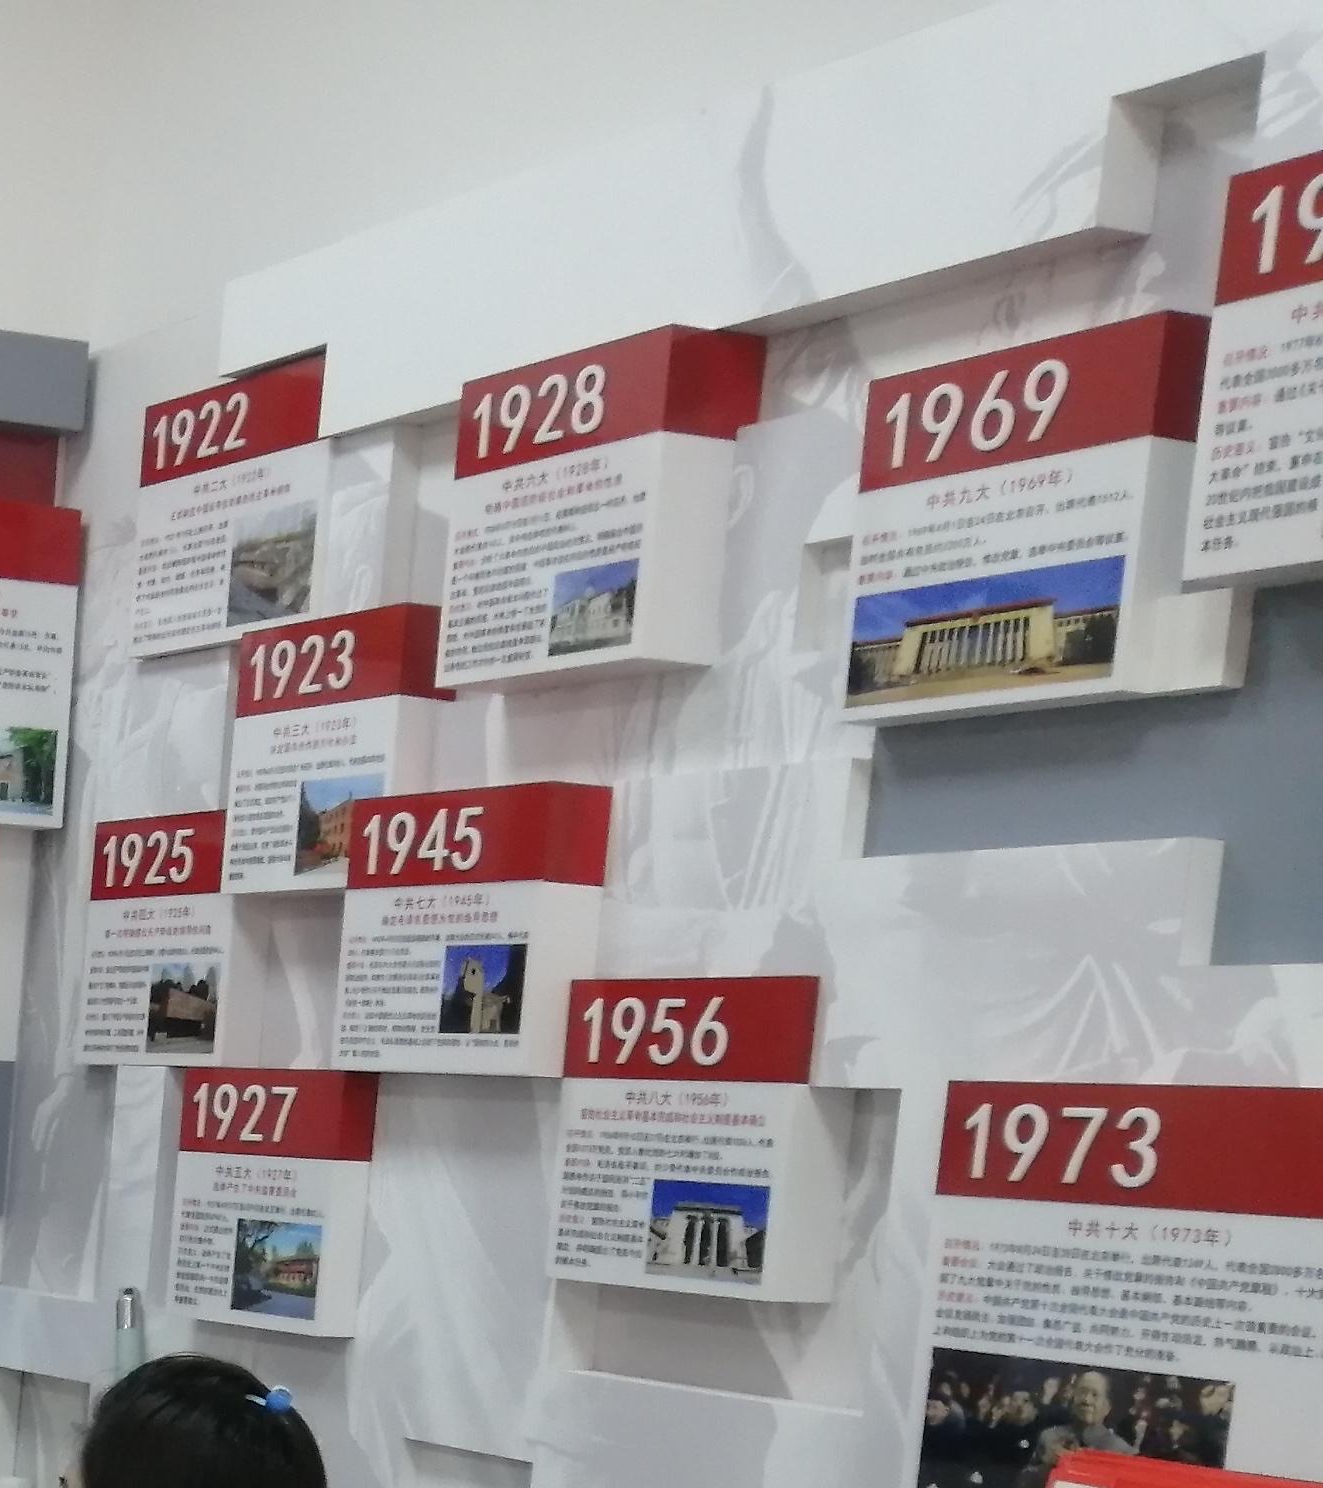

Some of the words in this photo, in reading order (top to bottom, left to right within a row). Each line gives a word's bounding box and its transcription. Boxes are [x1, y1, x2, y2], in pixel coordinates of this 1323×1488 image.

[152, 391, 249, 470] 1922
[472, 363, 606, 460] 1928
[885, 359, 1070, 469] 1969
[926, 468, 1073, 509] 中共九大（1969年）
[250, 629, 355, 701] 1923
[103, 828, 195, 888] 1925
[362, 806, 485, 875] 1945
[582, 995, 730, 1066] 1956
[193, 1082, 299, 1143] 1927
[964, 1102, 1162, 1189] 1973
[1068, 1218, 1233, 1247] 中共十大（1973年）
